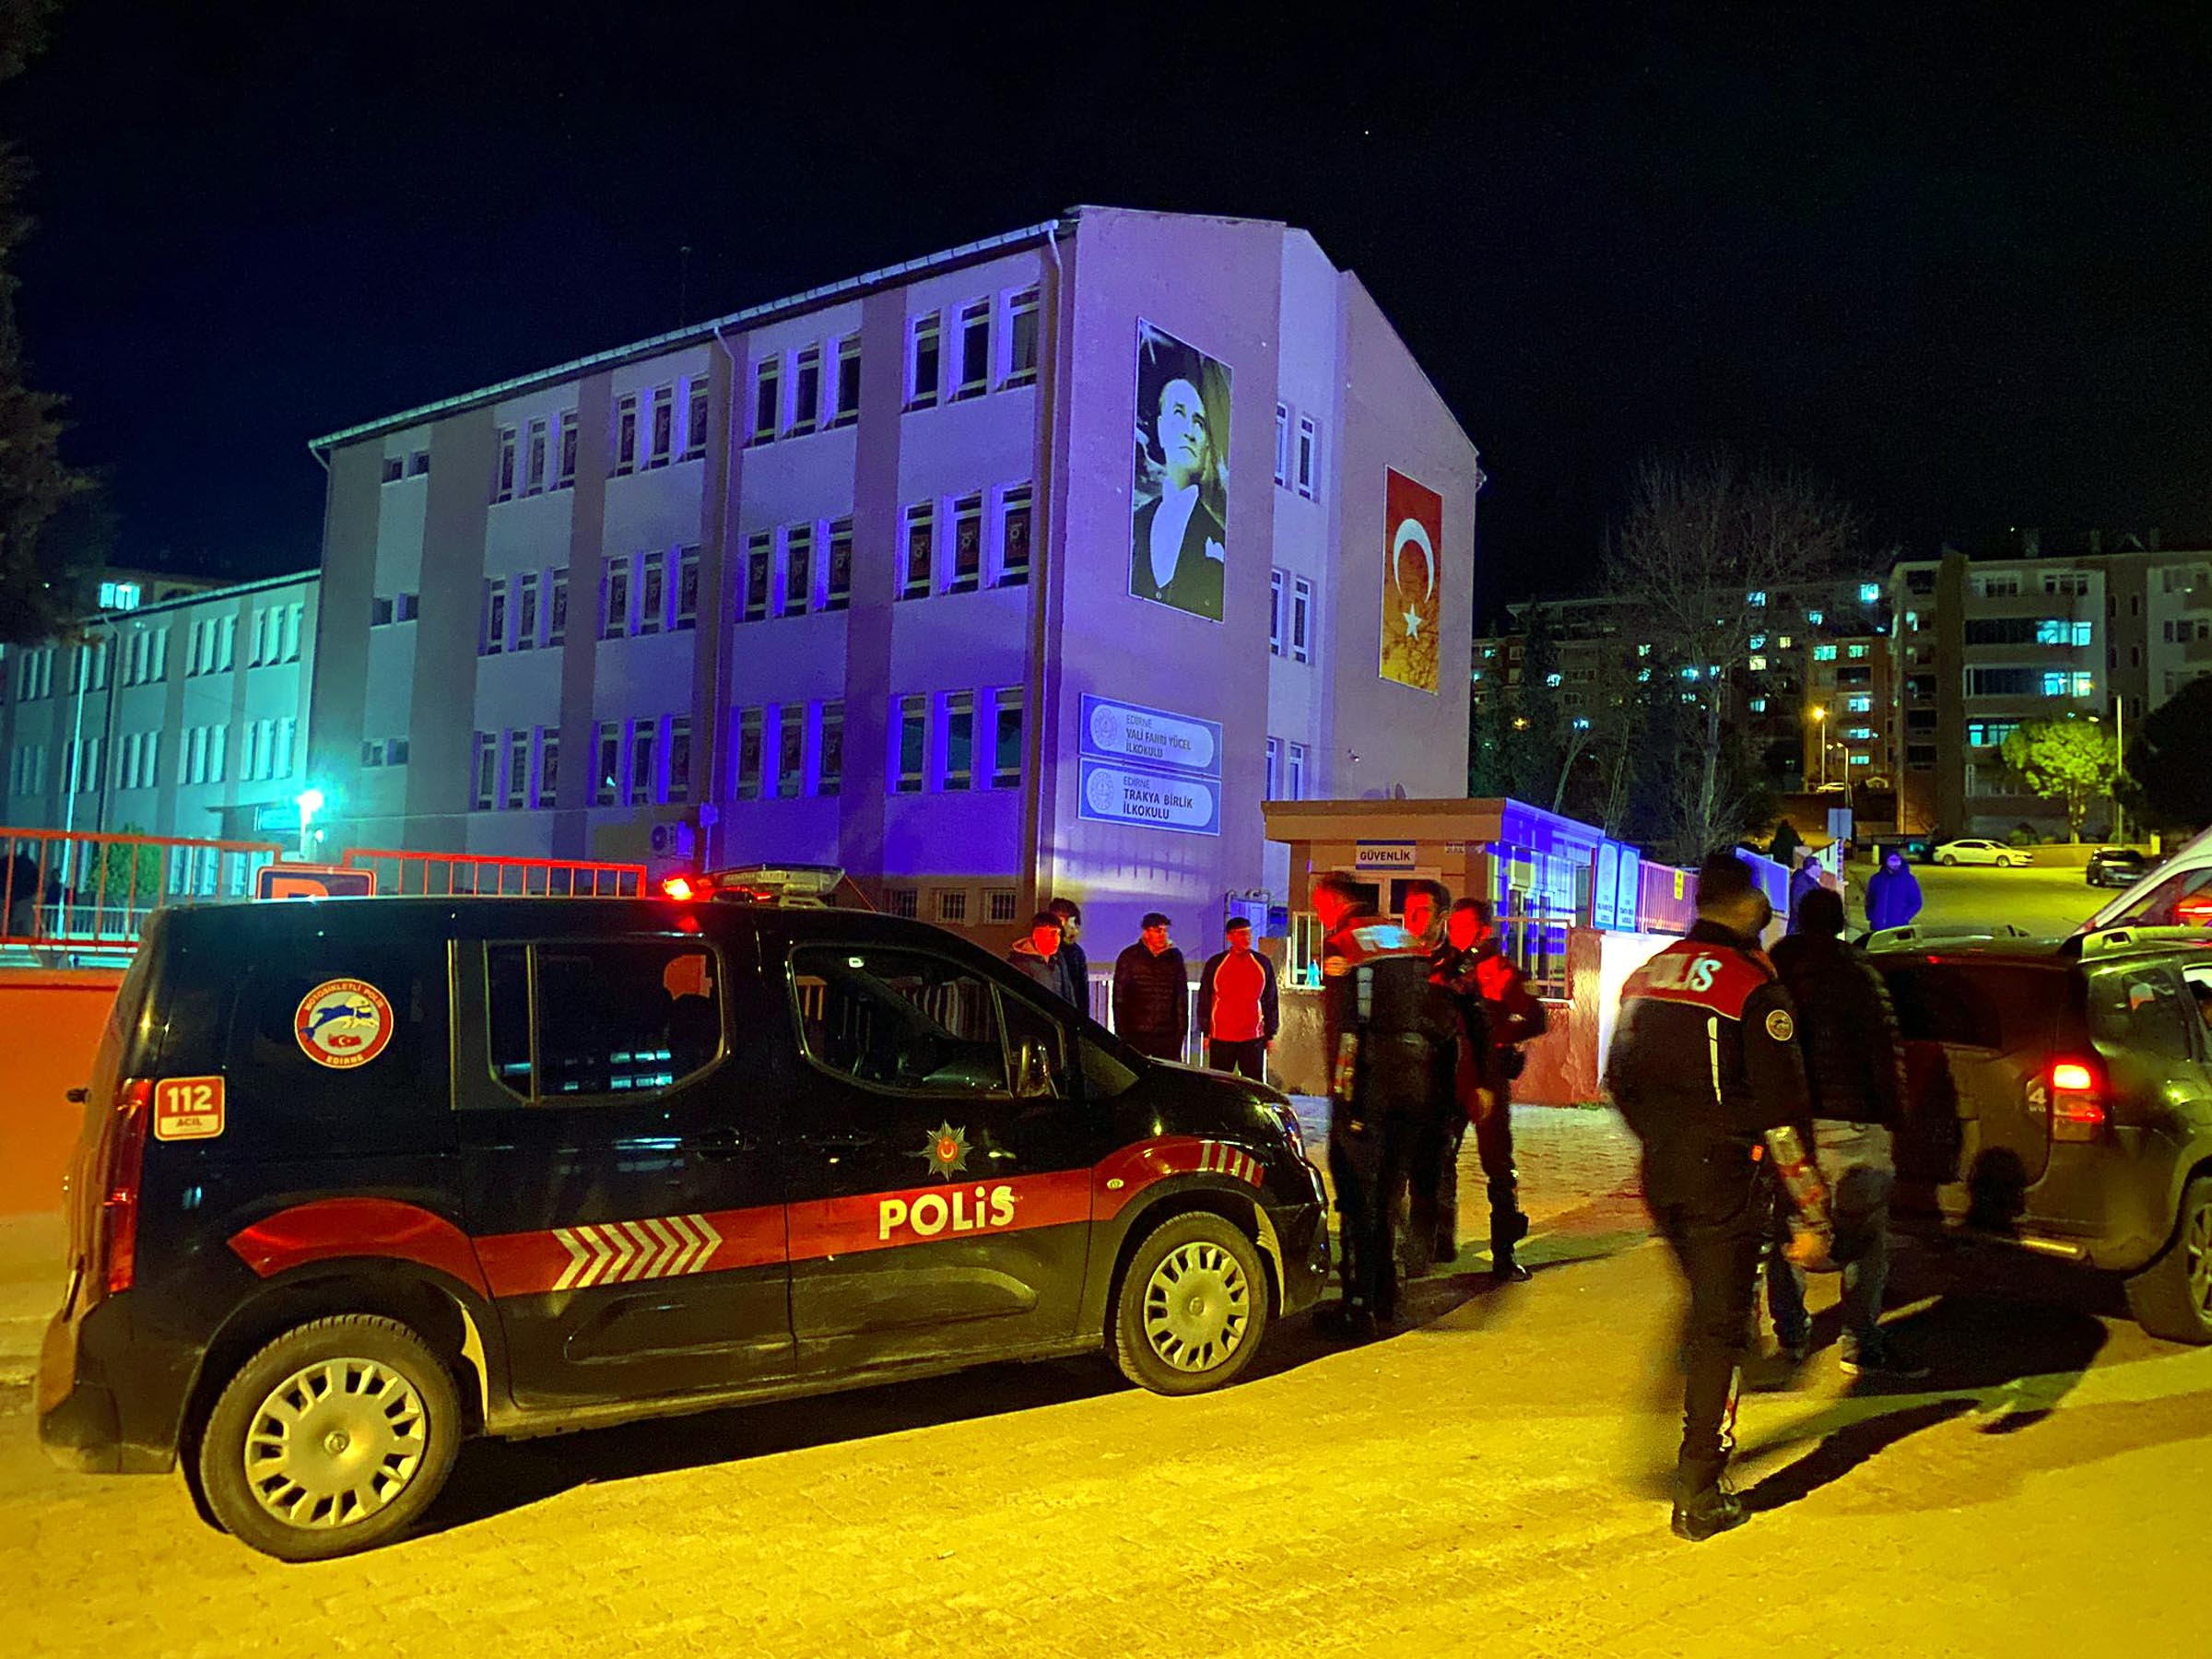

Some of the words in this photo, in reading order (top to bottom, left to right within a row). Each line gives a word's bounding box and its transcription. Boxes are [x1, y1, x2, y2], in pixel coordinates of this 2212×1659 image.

[1126, 738, 1163, 758] İLKOKULU
[1124, 788, 1159, 805] TRAKYA
[1163, 791, 1193, 808] BİRLİK
[1123, 800, 1170, 819] İLKOKULU
[1359, 849, 1410, 861] GÜVENLİK
[167, 1085, 212, 1113] 112
